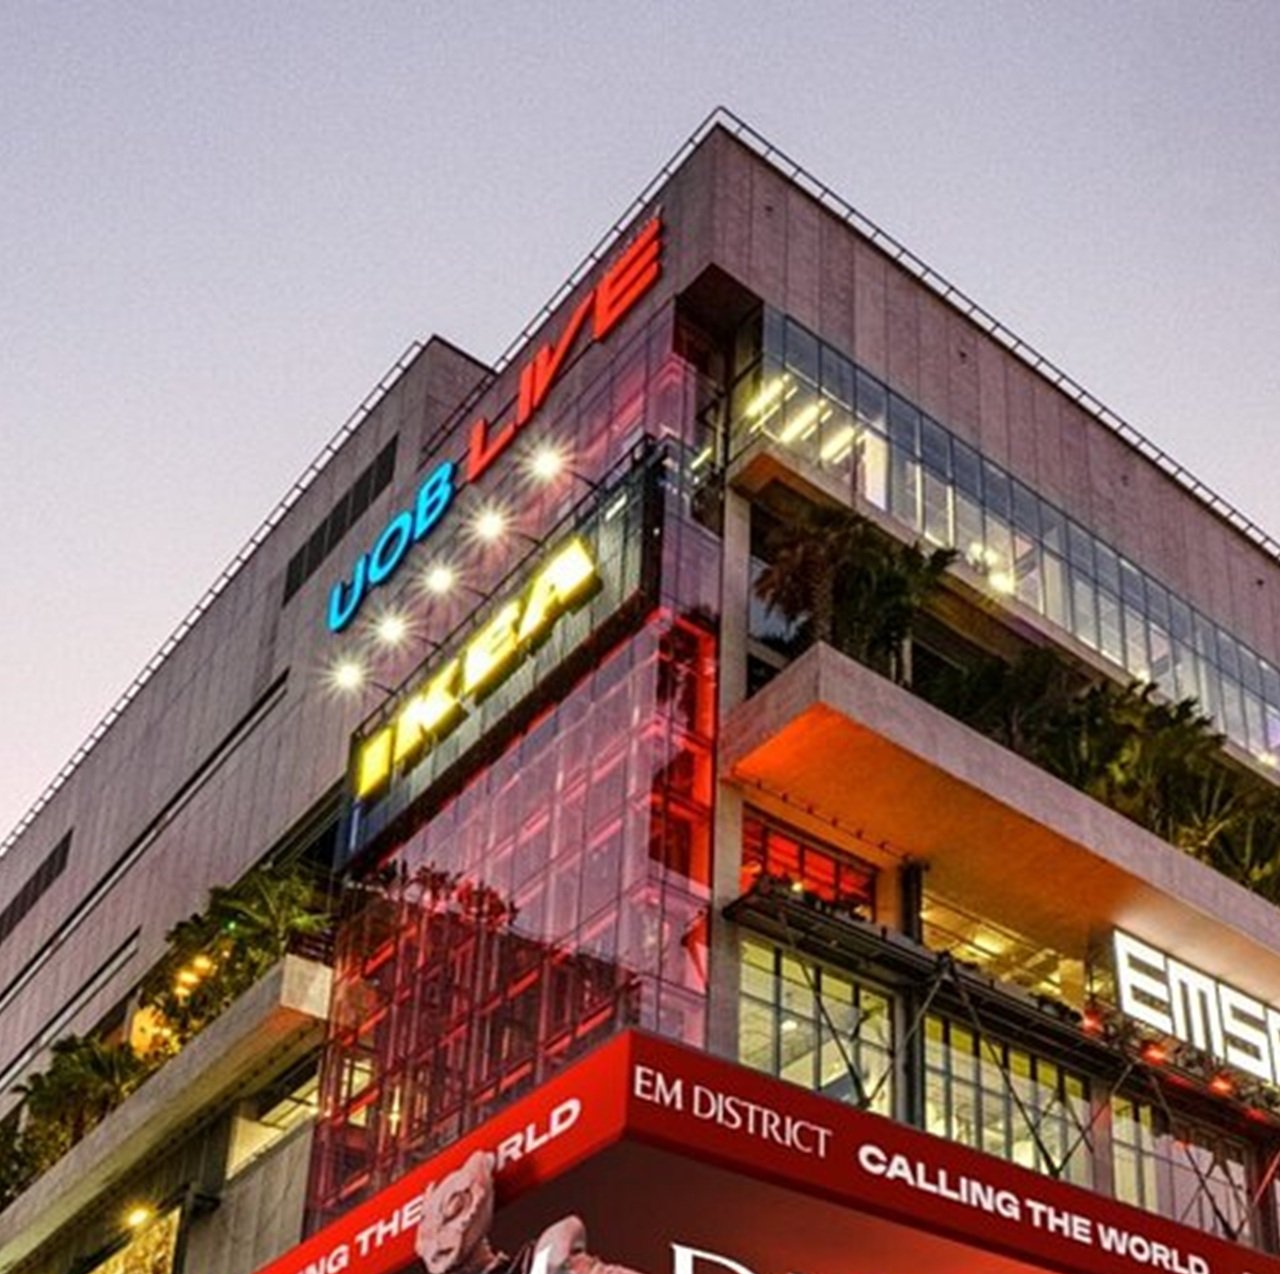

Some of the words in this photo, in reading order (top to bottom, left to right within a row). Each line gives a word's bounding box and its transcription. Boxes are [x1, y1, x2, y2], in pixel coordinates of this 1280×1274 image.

[328, 461, 457, 633] UOB
[468, 216, 663, 483] LIVE
[357, 537, 595, 797] IKEA
[354, 1195, 424, 1257] THE
[634, 1065, 684, 1111] EM
[693, 1084, 833, 1158] DISTRICT
[858, 1144, 1021, 1222] CALLING
[1024, 1199, 1093, 1245] THE
